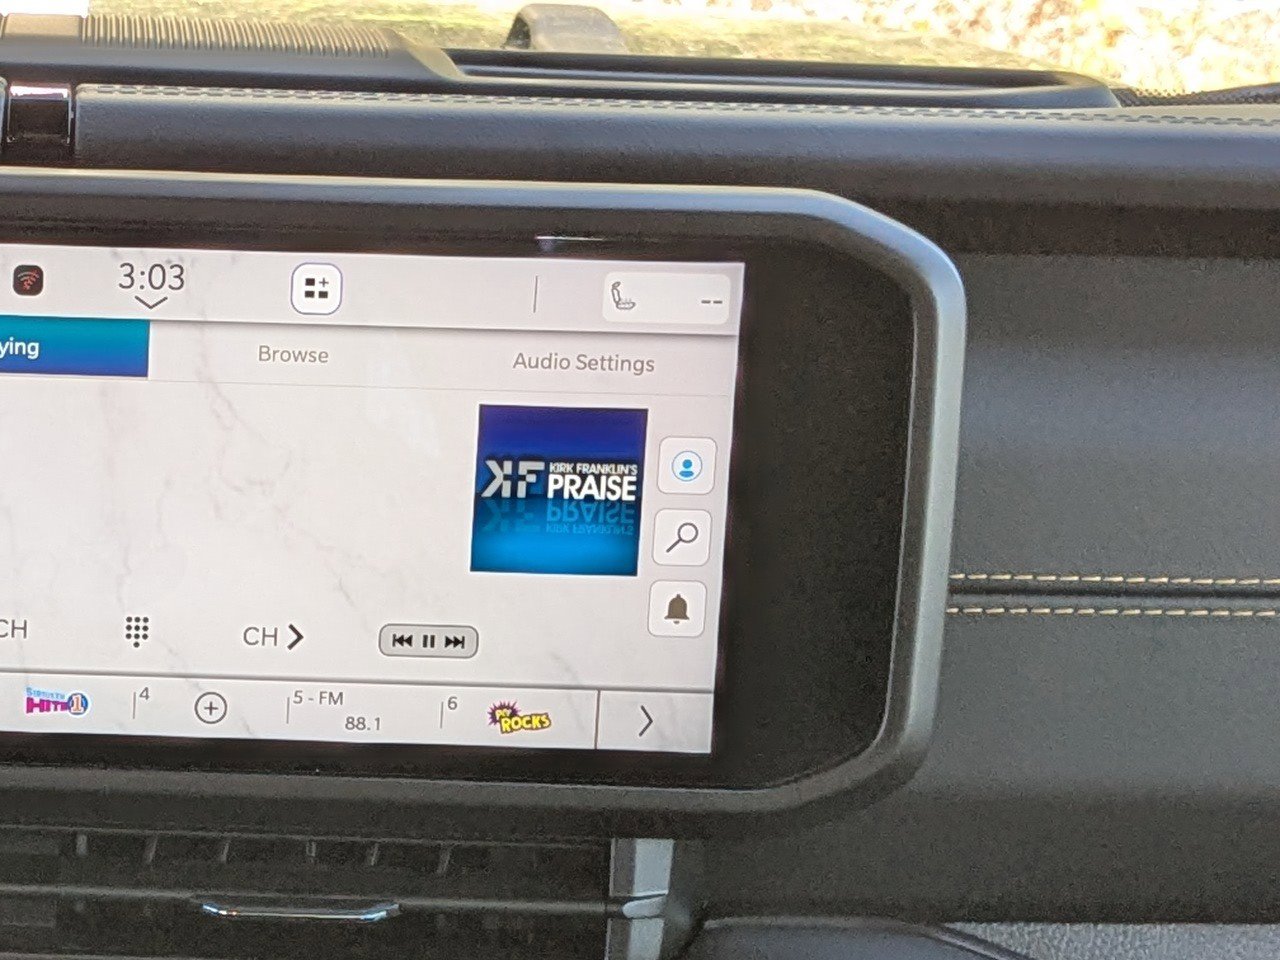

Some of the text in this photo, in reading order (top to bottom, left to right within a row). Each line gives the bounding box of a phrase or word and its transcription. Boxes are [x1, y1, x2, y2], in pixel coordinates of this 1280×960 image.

[118, 262, 186, 291] 3:03
[258, 345, 329, 364] Browse
[512, 352, 655, 374] Audio Settings
[549, 462, 574, 473] KIRK
[547, 474, 637, 501] PRAISE
[243, 626, 279, 646] CH
[139, 687, 150, 700] 4
[293, 690, 303, 704] 5
[319, 691, 343, 705] FM
[447, 696, 458, 710] 6
[345, 717, 381, 731] 88.1
[500, 713, 551, 734] ROCKS
